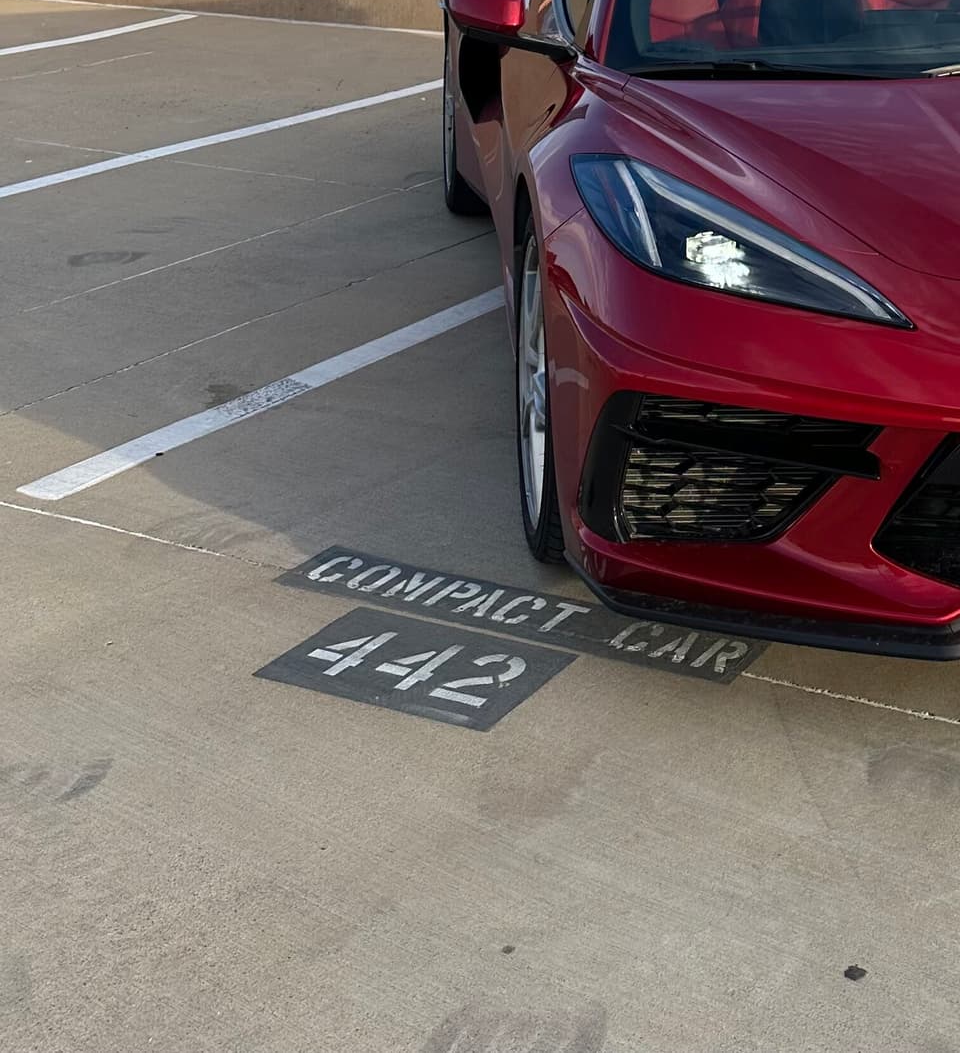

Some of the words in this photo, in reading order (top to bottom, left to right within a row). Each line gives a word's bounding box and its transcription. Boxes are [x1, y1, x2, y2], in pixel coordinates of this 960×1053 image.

[305, 555, 592, 634] COMPACT
[607, 621, 751, 674] CAR
[307, 631, 528, 708] 442
